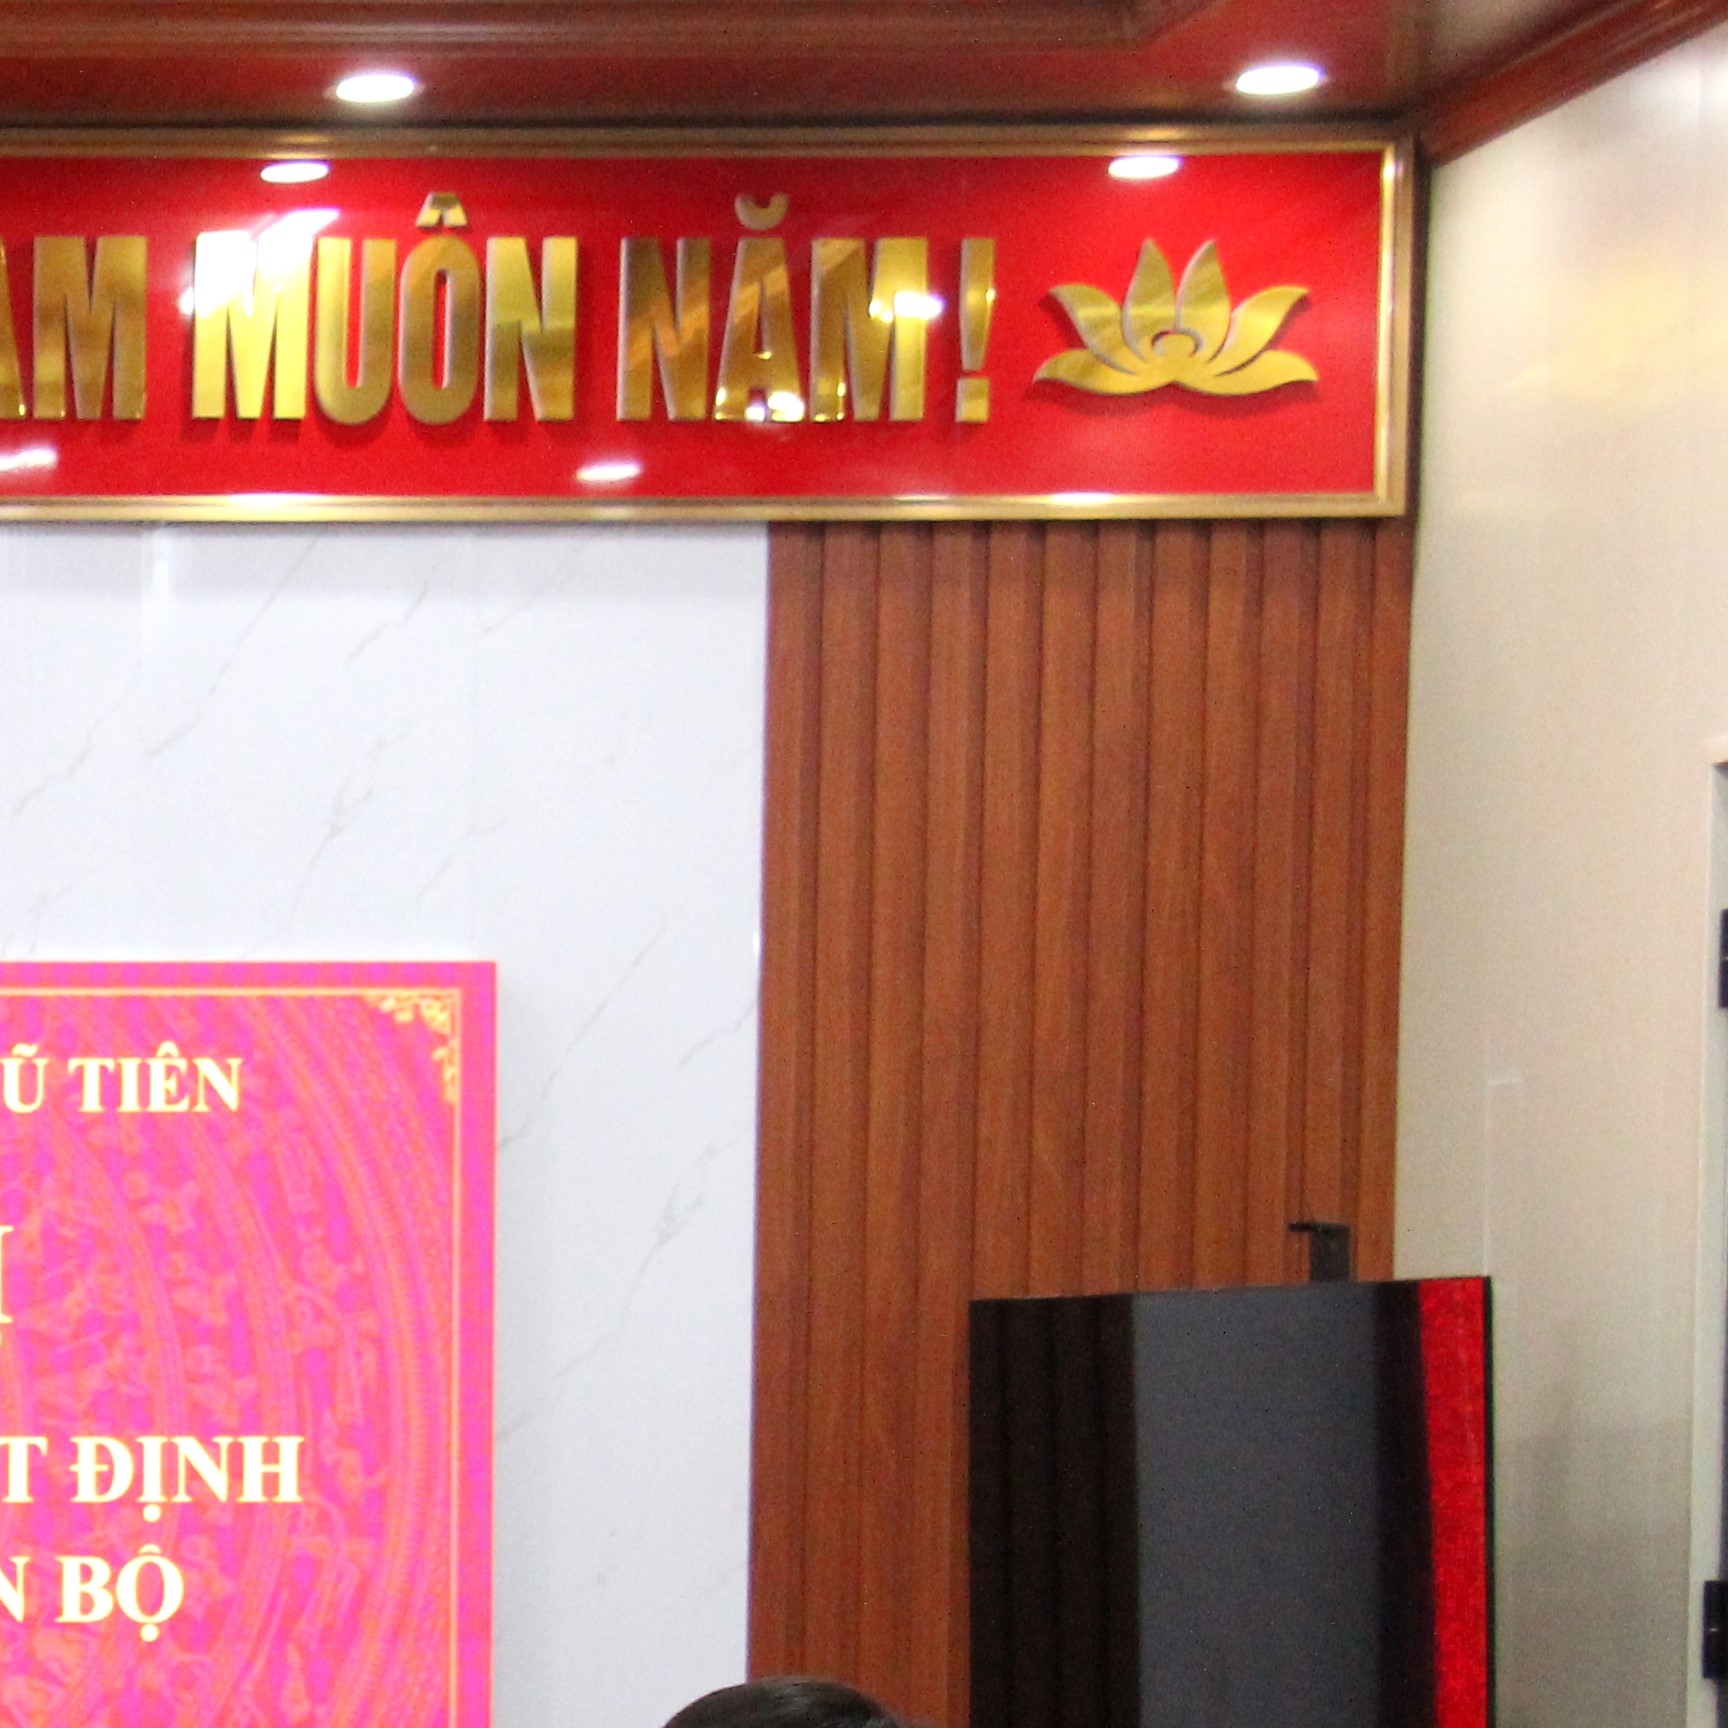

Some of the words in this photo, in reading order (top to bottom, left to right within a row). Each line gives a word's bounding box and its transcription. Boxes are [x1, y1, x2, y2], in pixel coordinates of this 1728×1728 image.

[191, 191, 578, 425] MUÔN
[67, 1040, 244, 1114] TIÊN
[68, 1434, 306, 1524] ĐỊNH
[54, 1543, 185, 1643] BỘ
